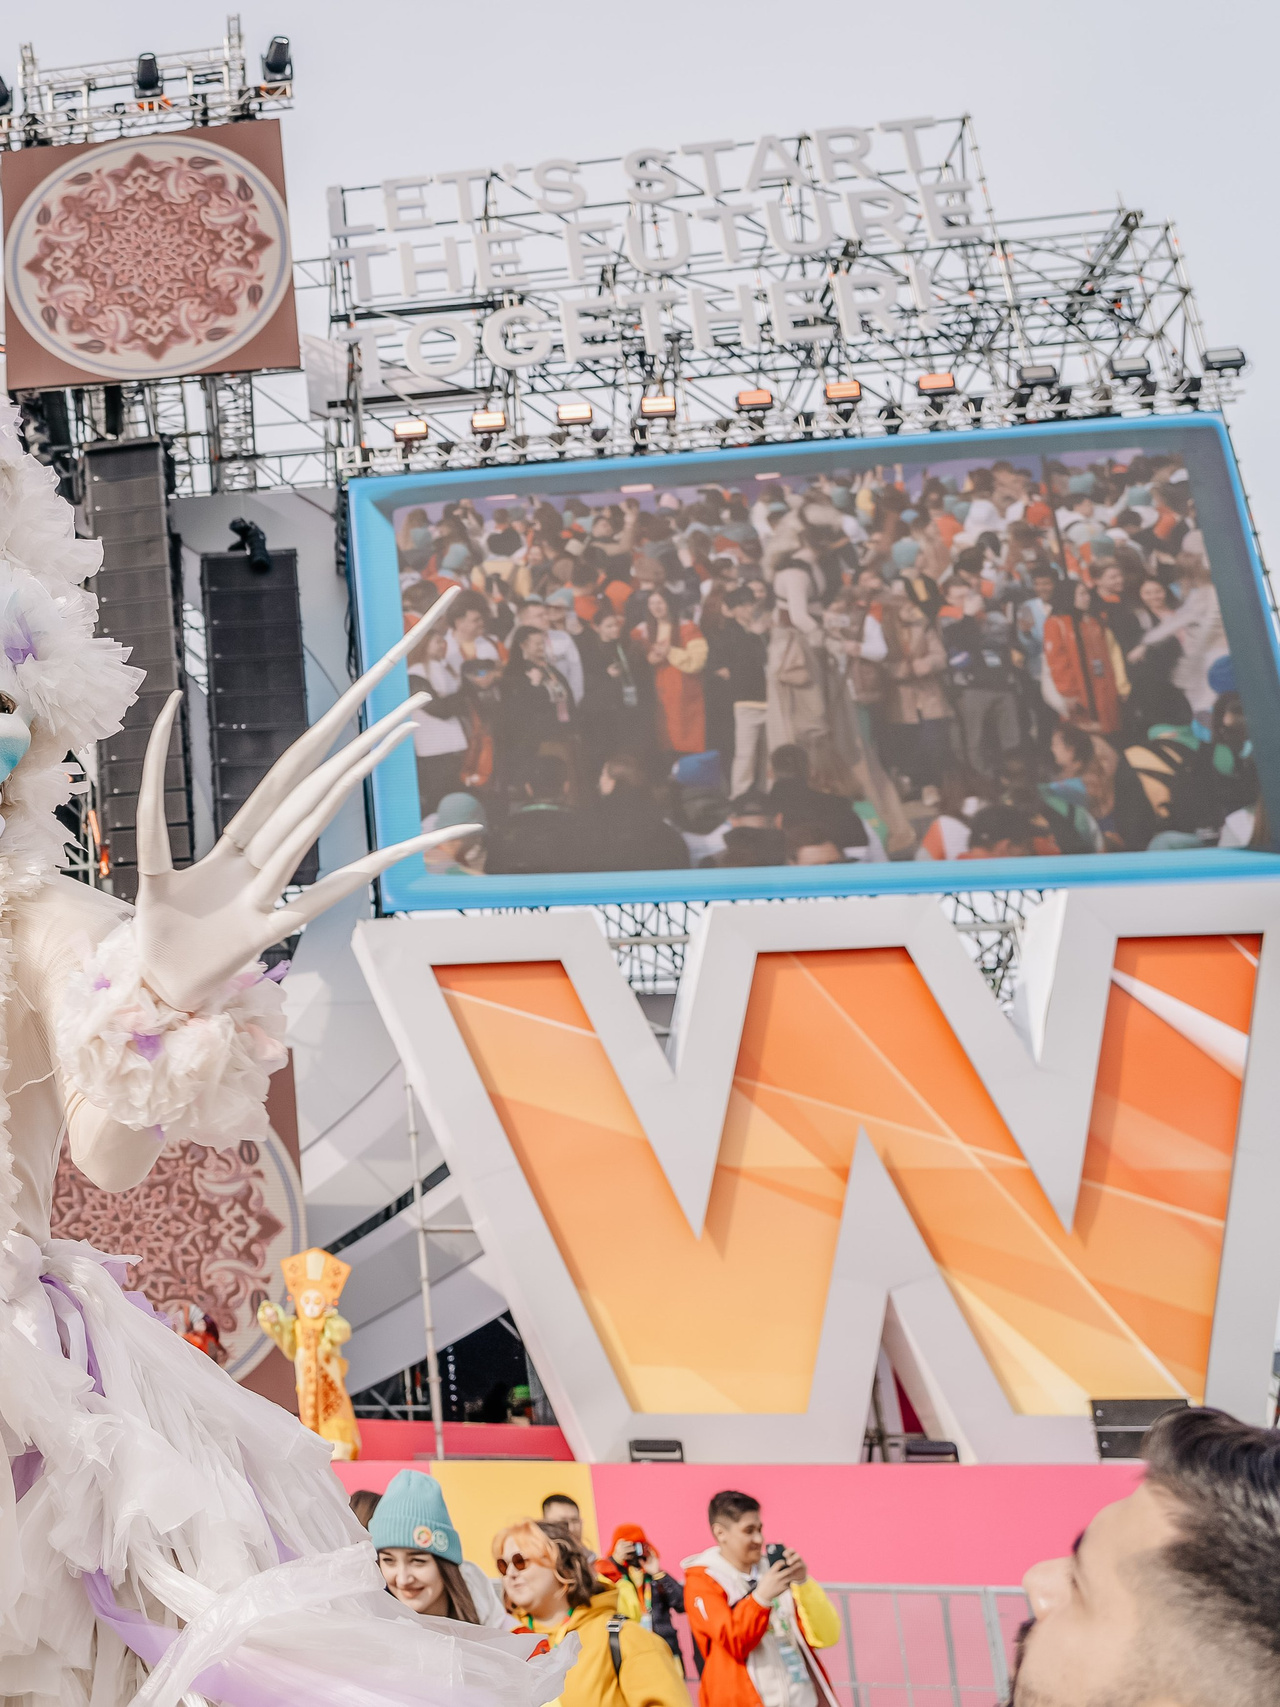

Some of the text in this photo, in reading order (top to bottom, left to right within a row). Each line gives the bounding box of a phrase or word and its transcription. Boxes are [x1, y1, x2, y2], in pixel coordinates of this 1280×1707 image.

[326, 116, 935, 238] LET'S START
[330, 179, 984, 302] THE FUTURE
[338, 267, 942, 390] TOGETHER!
